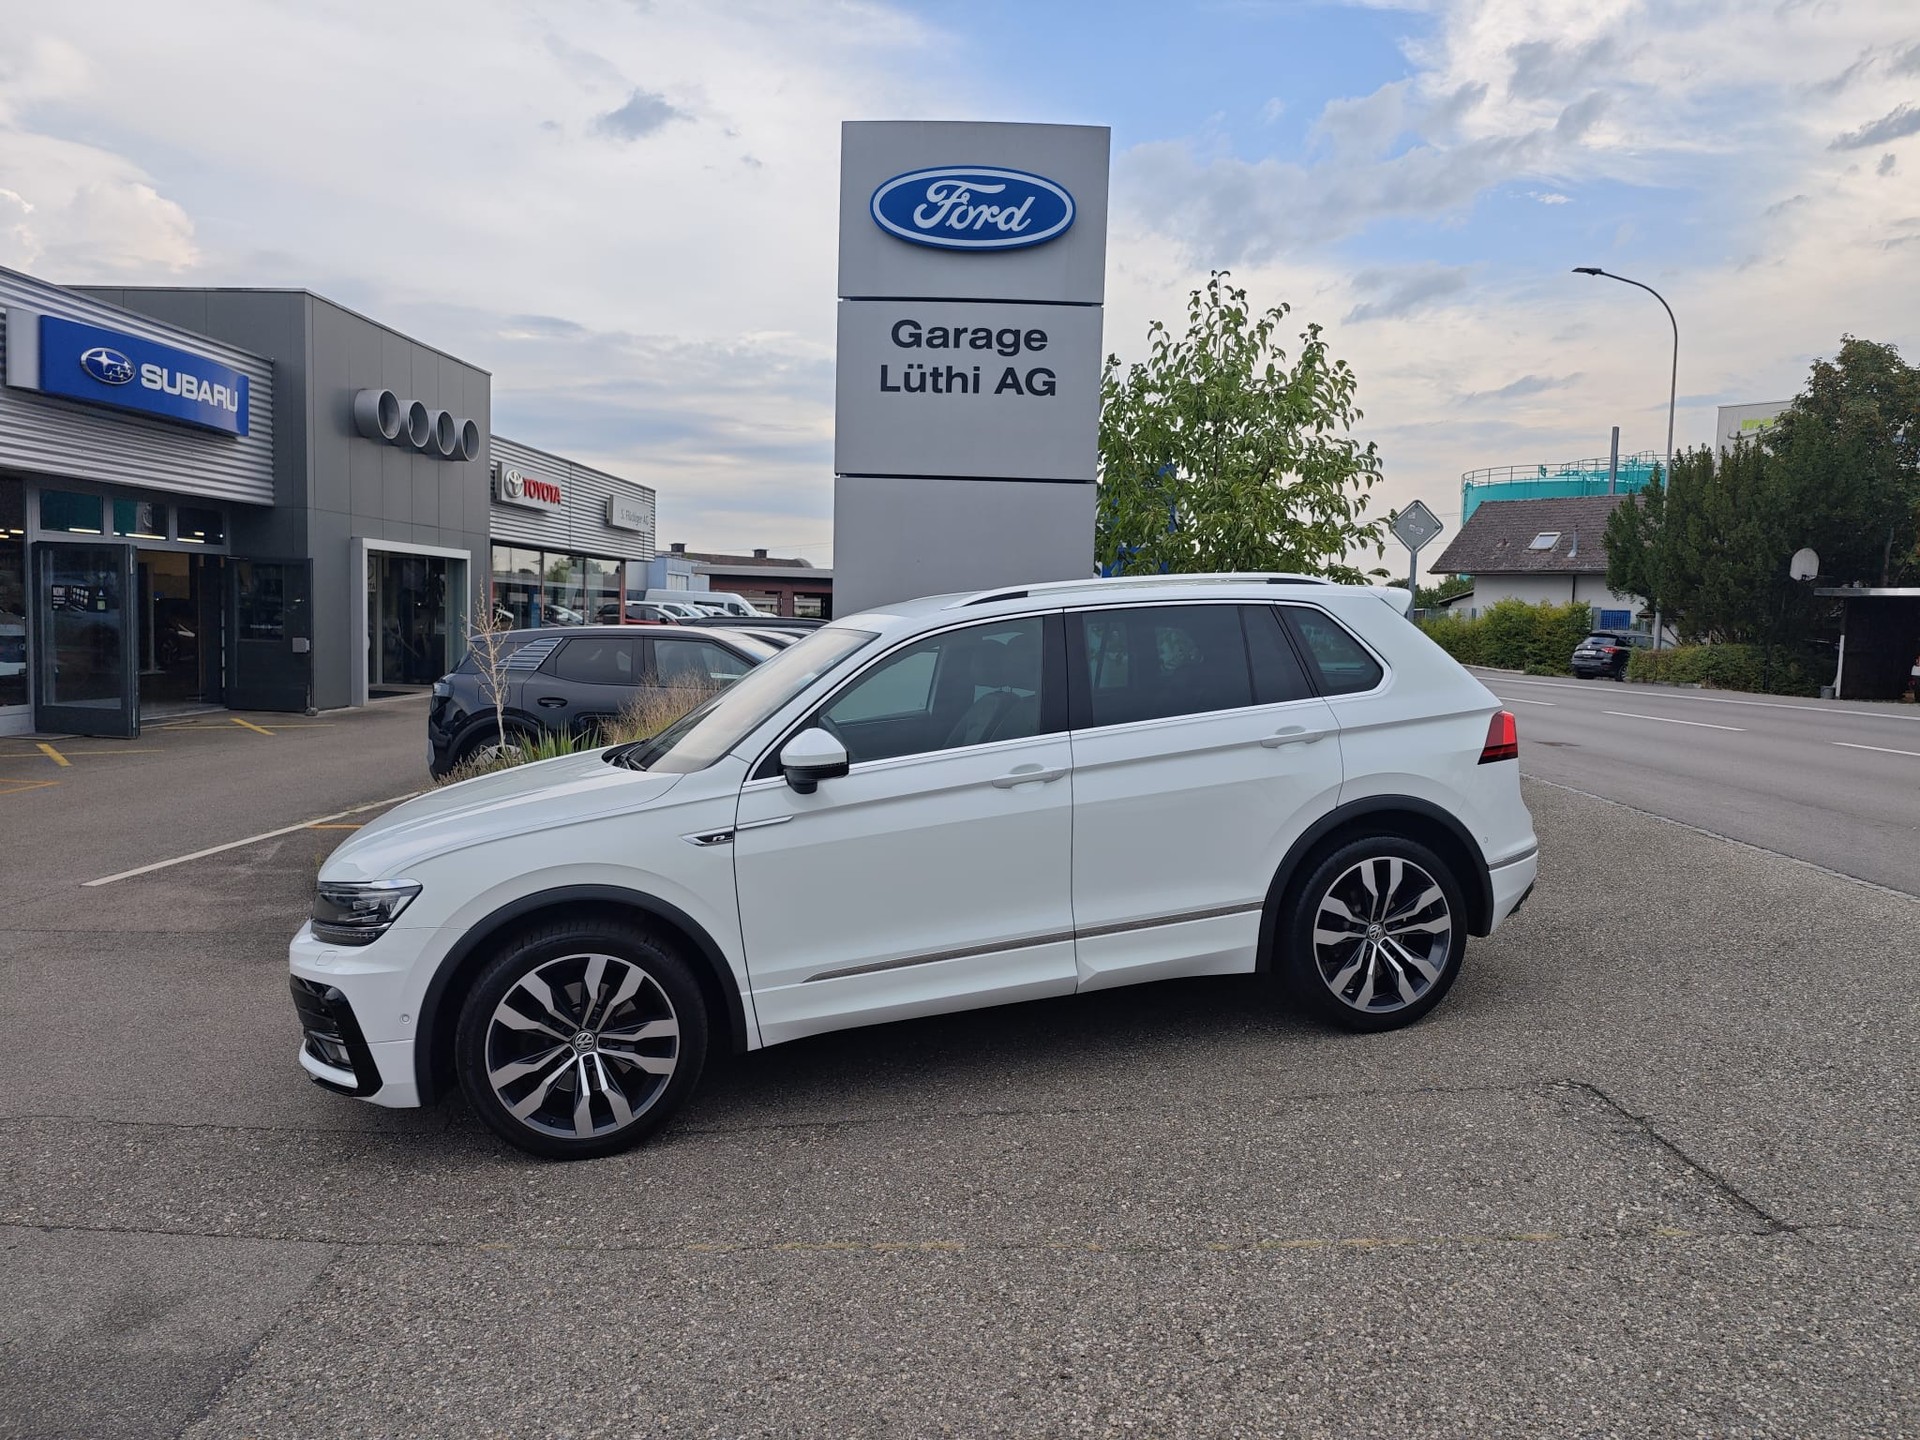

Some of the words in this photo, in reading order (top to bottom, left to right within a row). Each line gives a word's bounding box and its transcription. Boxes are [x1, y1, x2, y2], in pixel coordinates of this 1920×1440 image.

[913, 179, 1035, 233] Ford
[891, 319, 1048, 357] Garage
[140, 363, 238, 413] SUBARU
[880, 363, 980, 394] Lüthi
[994, 367, 1056, 396] AG
[523, 478, 561, 505] TOYOTA
